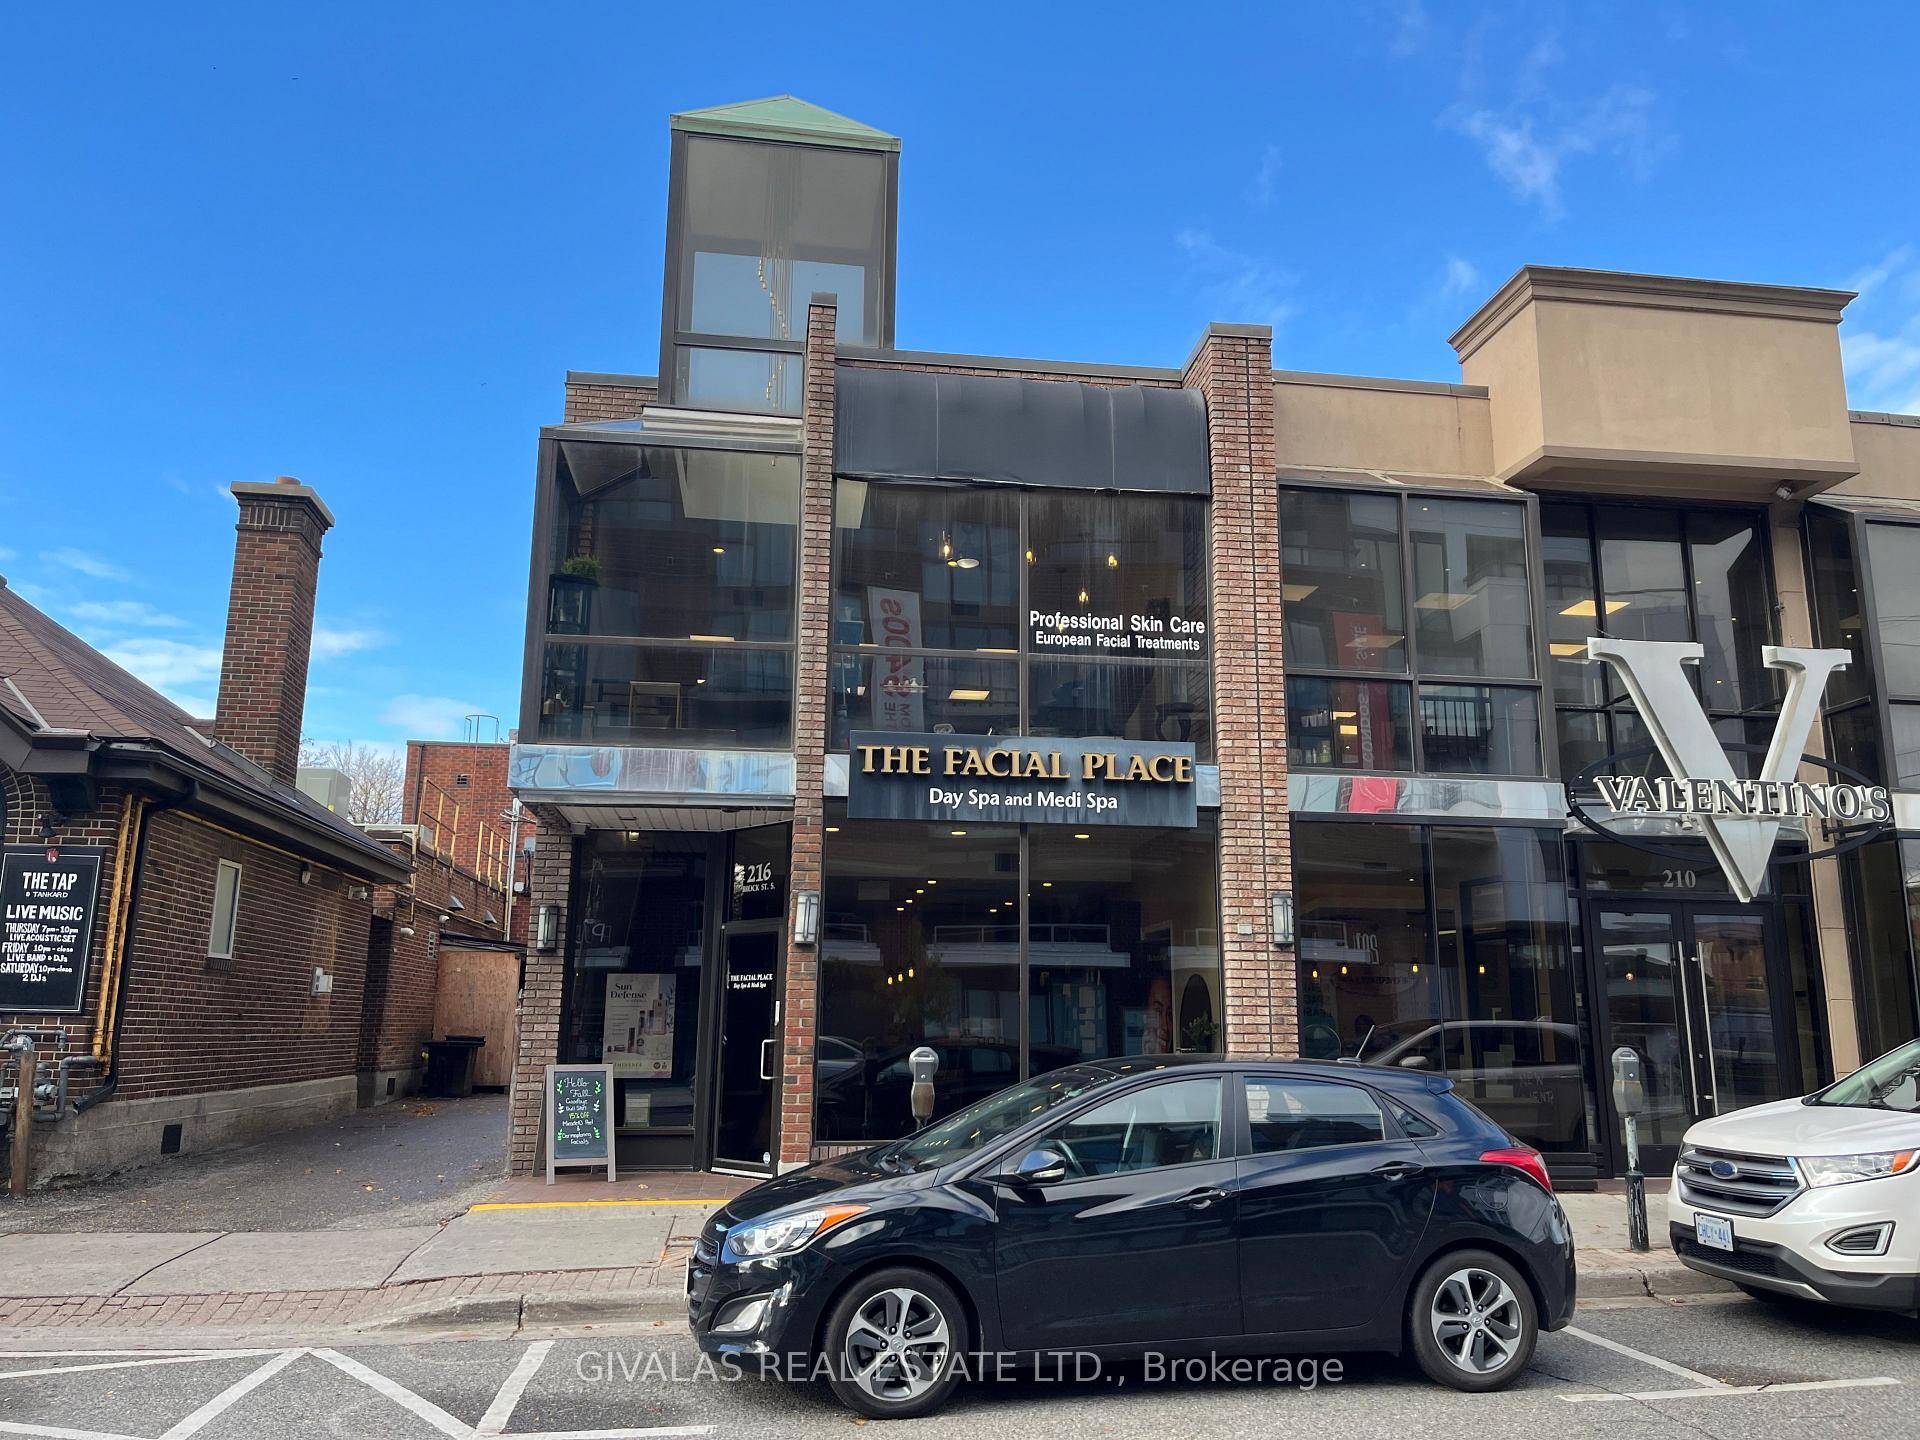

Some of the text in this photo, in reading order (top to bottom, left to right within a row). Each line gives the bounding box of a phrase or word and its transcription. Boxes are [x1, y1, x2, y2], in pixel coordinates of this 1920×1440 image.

[1029, 611, 1206, 634] Professional Skin Care
[1035, 630, 1200, 651] European Facial Treatments
[856, 745, 1194, 783] THE FACIAL PLACE
[929, 787, 1118, 814] Day Spa and Medi Spa
[1592, 775, 1890, 822] VALENTINO'S
[747, 862, 772, 883] 216
[1662, 869, 1696, 888] 210
[22, 871, 78, 891] THE TAP
[6, 904, 84, 921] LIVE MUSIC
[5, 922, 41, 934] THURSDAY
[9, 934, 77, 943] LIVE ACOUSTIC SET
[1, 942, 30, 953] FRIDAY
[56, 945, 74, 953] close
[6, 953, 26, 962] LIVE
[26, 953, 46, 962] BAND
[0, 962, 40, 974] SATURDAY
[22, 974, 29, 982] 2
[610, 991, 647, 1000] Defense
[564, 1077, 589, 1087] Hello
[569, 1088, 592, 1098] Fall
